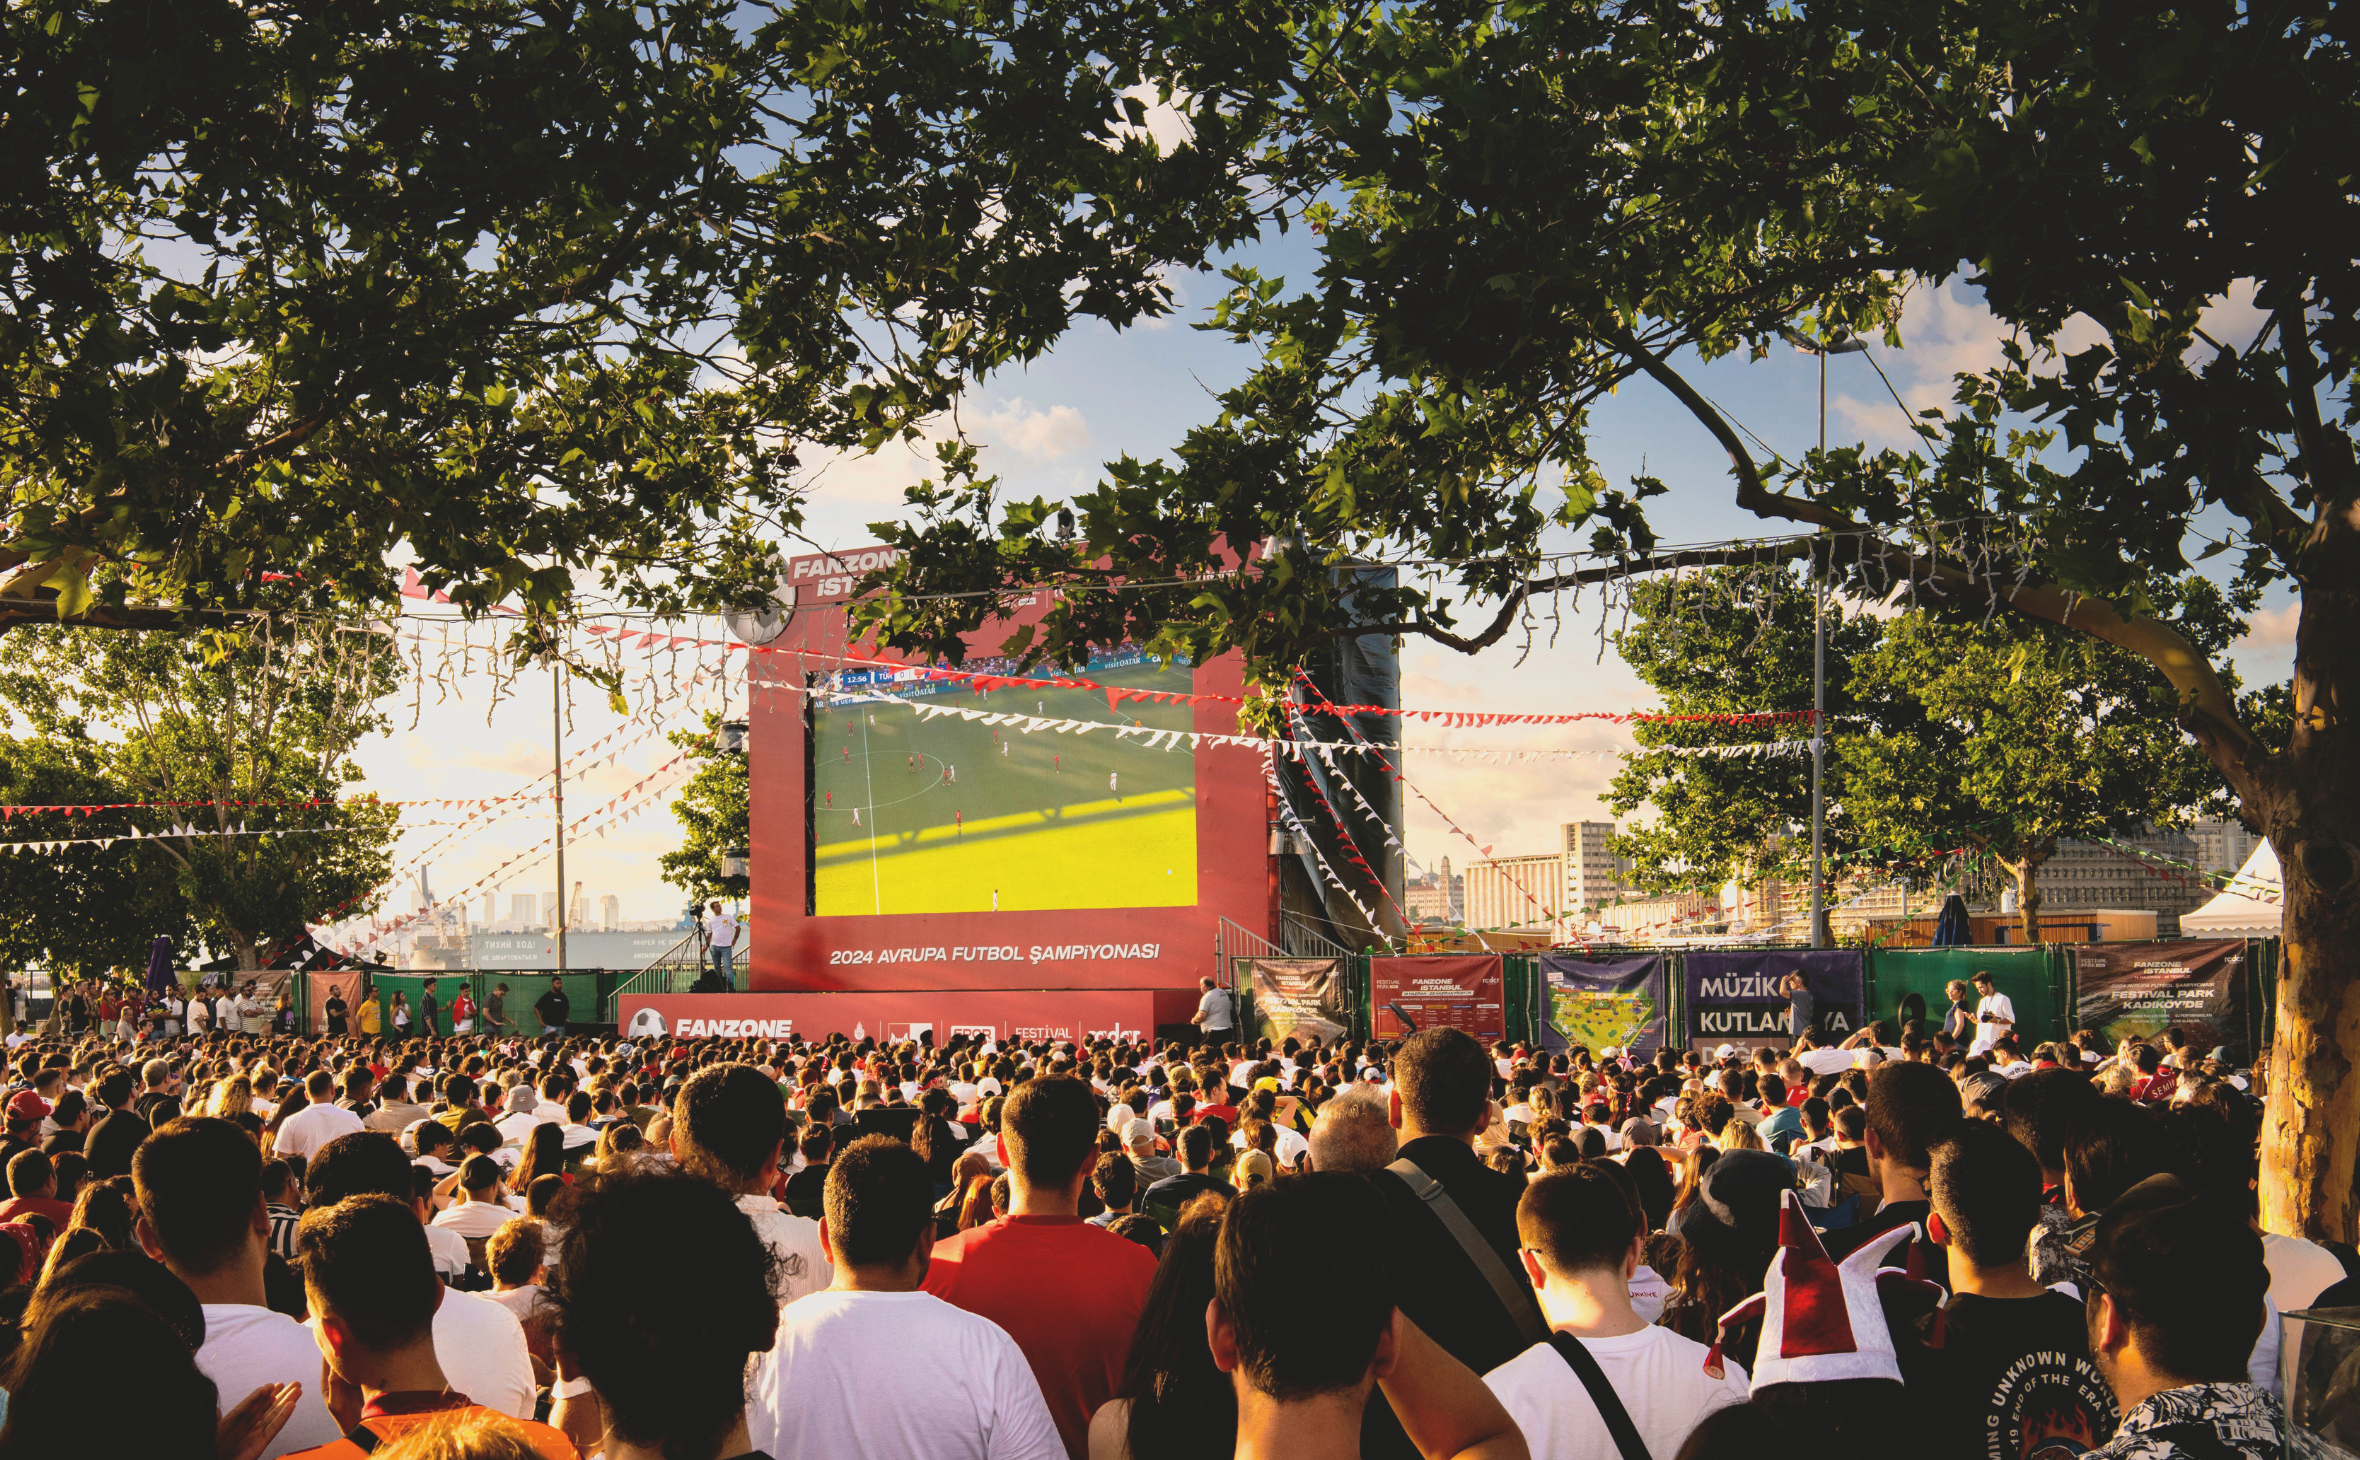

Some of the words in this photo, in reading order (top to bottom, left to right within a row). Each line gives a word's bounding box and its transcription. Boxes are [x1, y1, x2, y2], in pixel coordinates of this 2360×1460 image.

[847, 675, 867, 683] 12:56
[900, 688, 936, 699] visitQATAR
[485, 939, 512, 949] ТИХИЙ
[830, 950, 874, 965] 2024
[877, 947, 947, 963] AVRUPA
[952, 946, 1025, 961] FUTBOL
[2177, 989, 2215, 998] PARK
[675, 1019, 793, 1038] FANZONE
[1991, 1351, 2066, 1407] UNKNOWN
[2012, 1393, 2024, 1422] END
[2024, 1377, 2037, 1393] OF
[2041, 1373, 2070, 1386] THE
[2078, 1384, 2102, 1411] ERA
